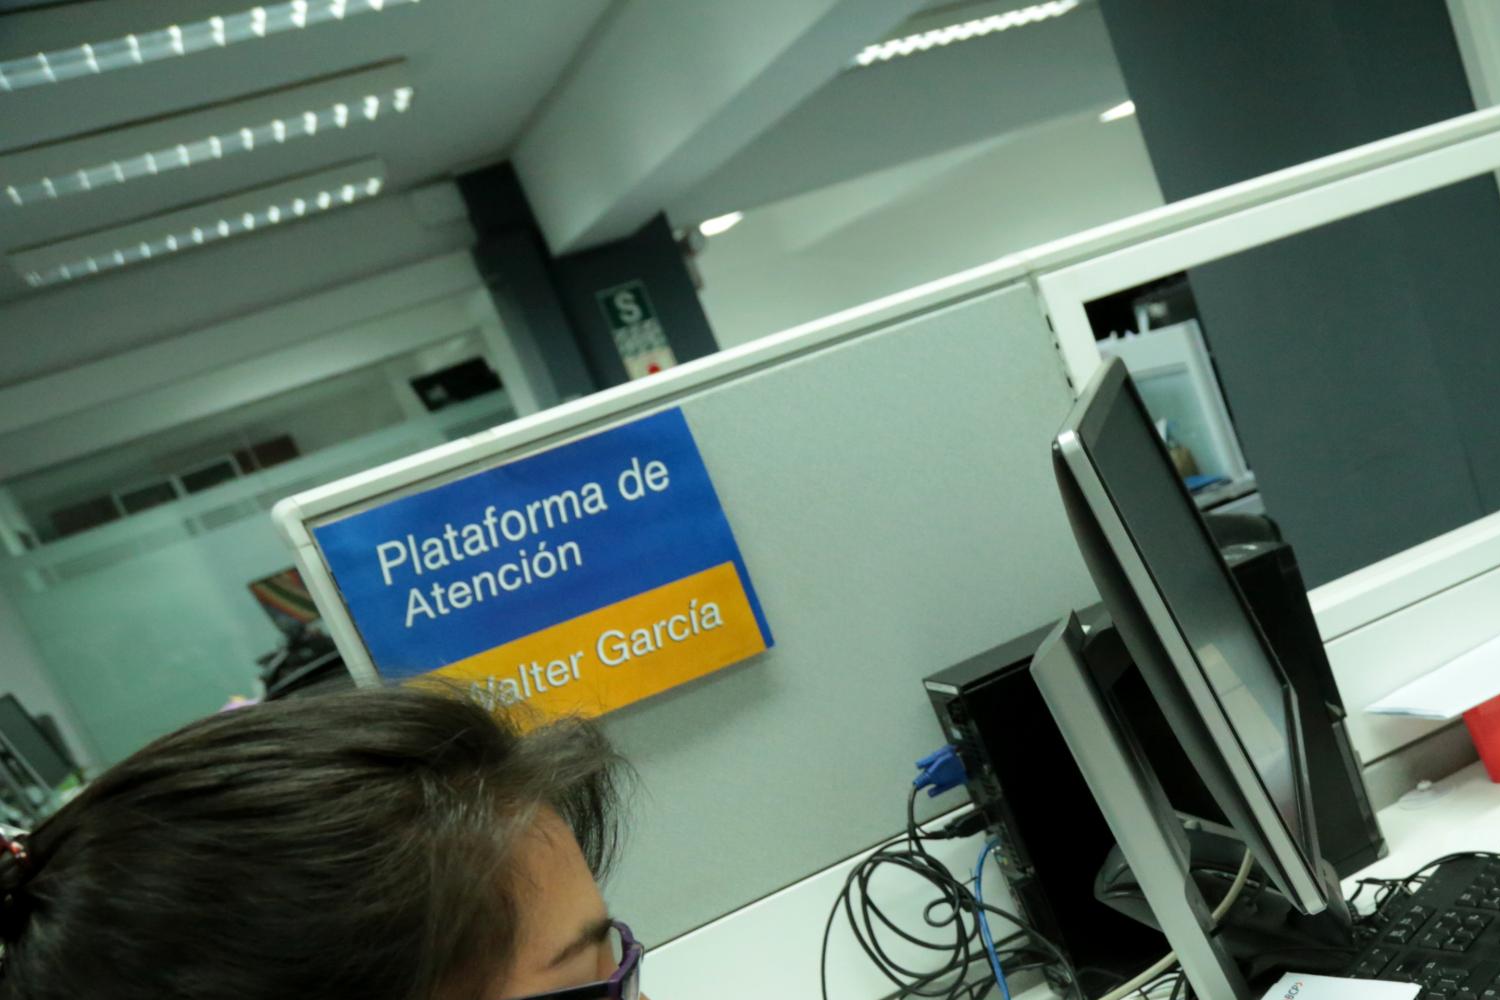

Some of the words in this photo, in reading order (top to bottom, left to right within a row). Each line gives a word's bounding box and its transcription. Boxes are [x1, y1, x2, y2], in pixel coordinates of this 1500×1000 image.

[375, 479, 609, 586] Plataforma
[617, 457, 670, 501] de
[404, 540, 583, 629] Atención
[597, 598, 723, 667] García
